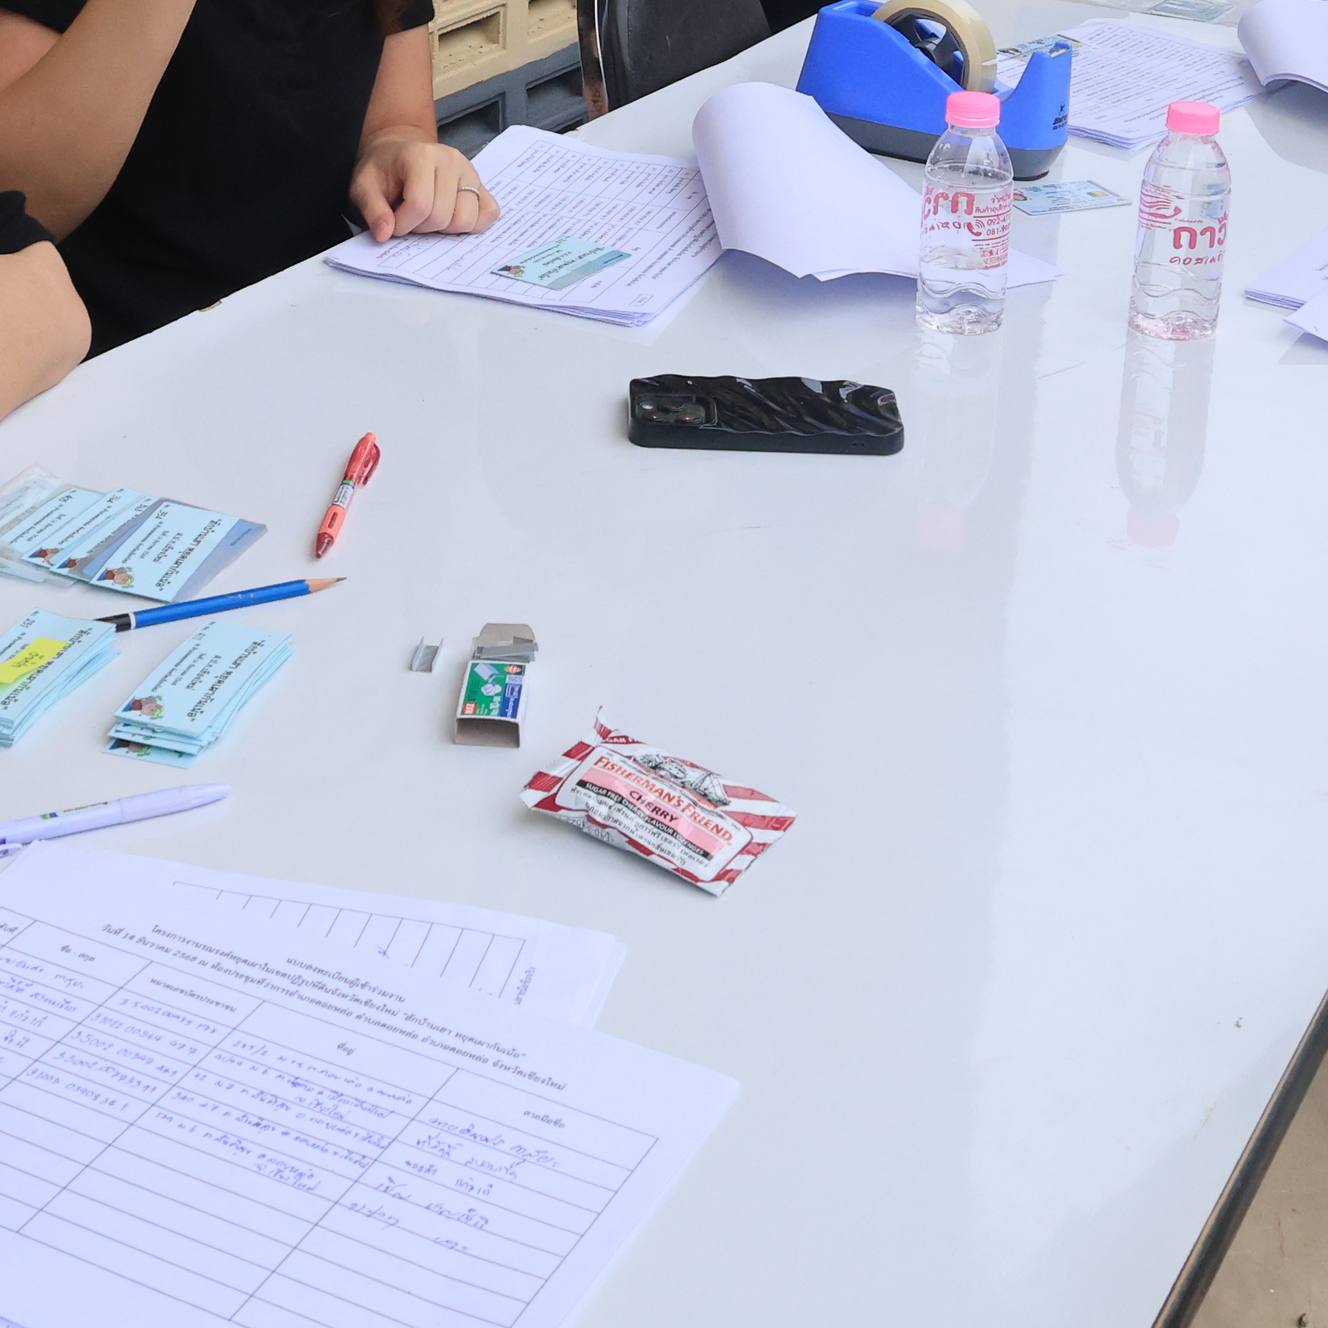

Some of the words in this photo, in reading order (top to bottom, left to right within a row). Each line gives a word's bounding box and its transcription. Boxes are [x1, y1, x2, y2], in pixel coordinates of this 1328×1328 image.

[585, 782, 607, 798] SUGAR
[606, 791, 622, 804] FREE
[621, 798, 645, 817] CHERRY
[644, 815, 674, 836] FLAVOUR
[673, 830, 704, 855] LOZENGES
[593, 756, 682, 808] FISHERMAN'S
[681, 803, 733, 843] FRIEND
[628, 790, 679, 822] CHERRY
[101, 921, 125, 938] วันที่
